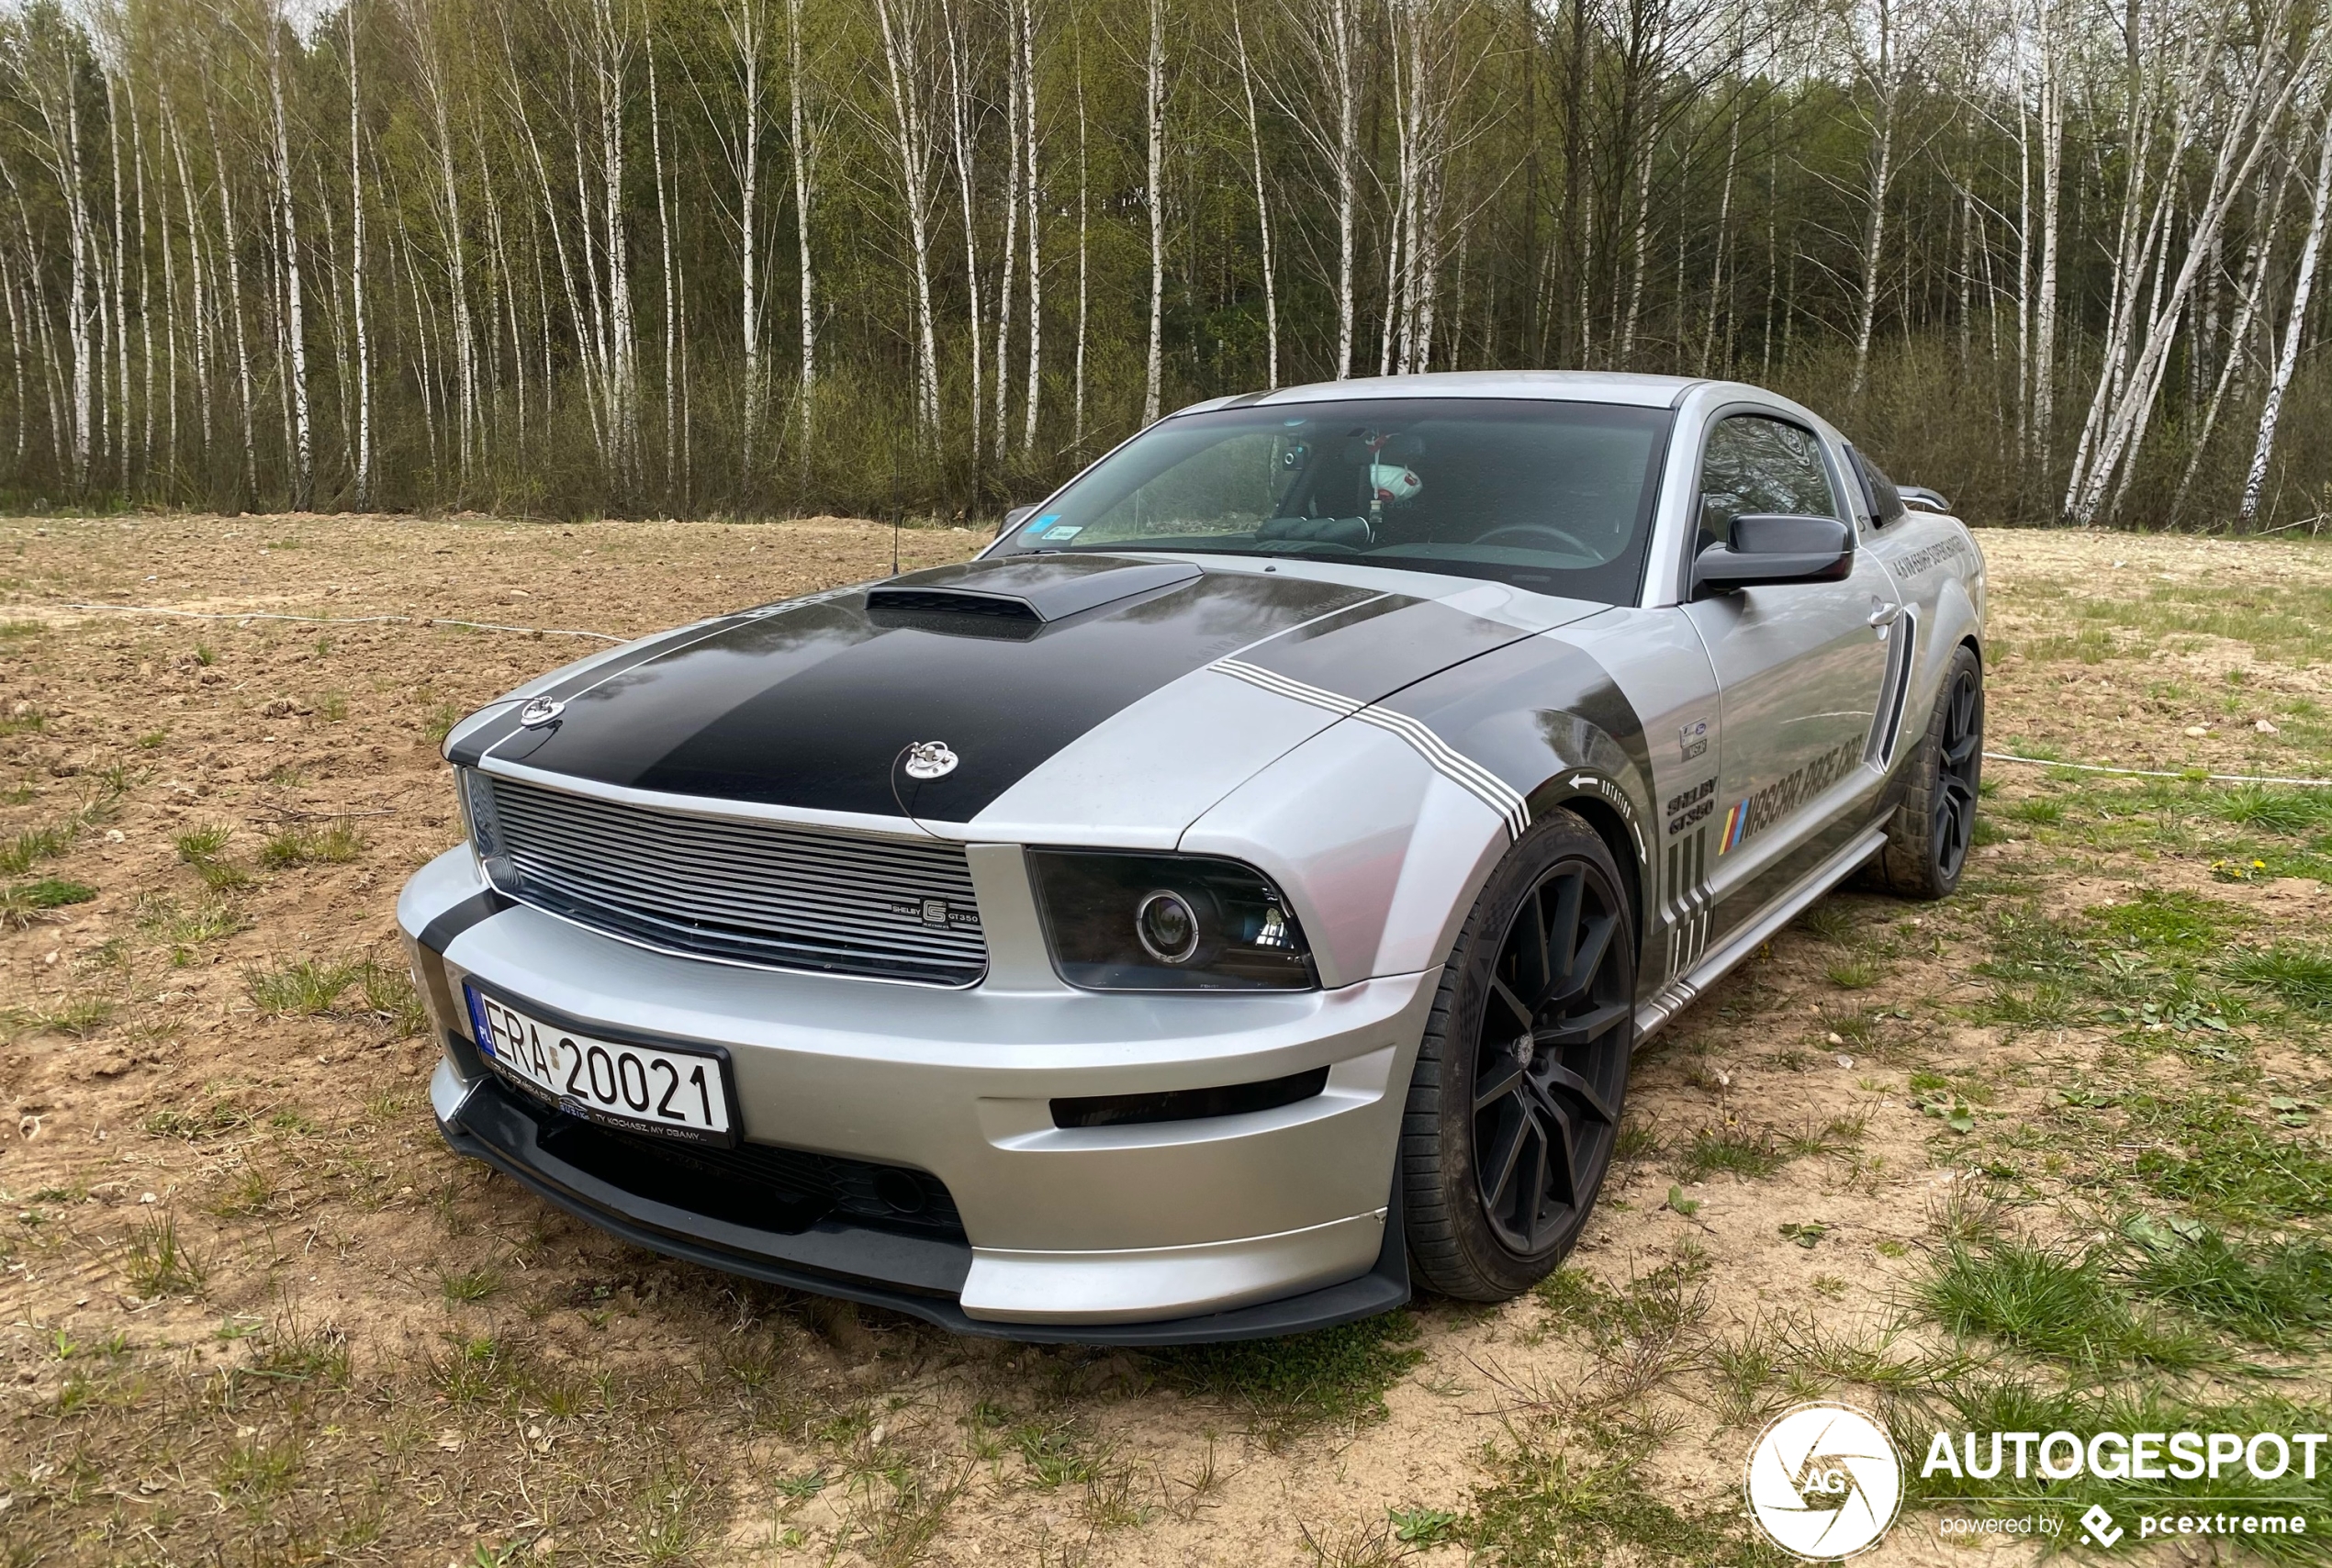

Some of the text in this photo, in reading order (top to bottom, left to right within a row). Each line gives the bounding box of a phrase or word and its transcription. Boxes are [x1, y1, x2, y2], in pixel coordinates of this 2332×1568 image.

[1601, 779, 1631, 819] ROTATION
[1667, 776, 1718, 817] SHELBY
[1743, 734, 1864, 840] NASCAR PACE CAR
[891, 905, 921, 915] SHELBY
[948, 913, 979, 923] GT350
[479, 1025, 492, 1045] PL
[483, 997, 713, 1126] ERA 20021
[595, 1114, 606, 1124] TY
[607, 1115, 650, 1133] KOCHASZ,
[650, 1126, 664, 1135] MY
